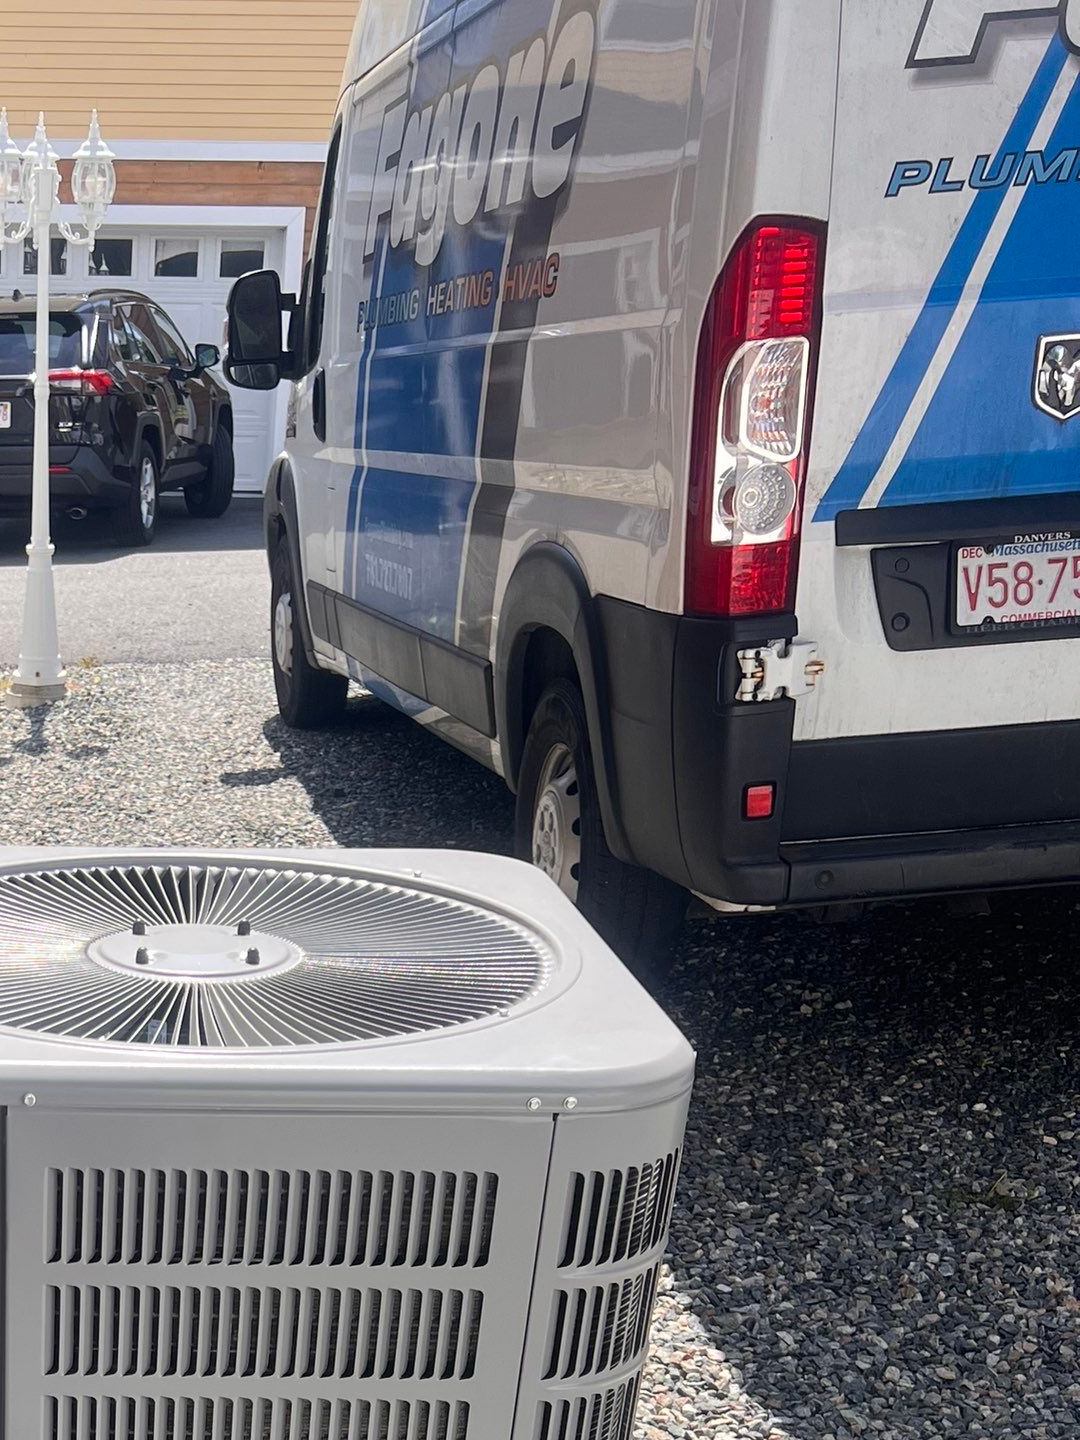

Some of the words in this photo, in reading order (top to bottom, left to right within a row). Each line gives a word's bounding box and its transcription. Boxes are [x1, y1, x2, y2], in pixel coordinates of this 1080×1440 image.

[364, 8, 598, 267] Fagone
[884, 147, 1080, 198] PLUM
[357, 288, 420, 332] PLUMBING
[426, 270, 493, 317] HEATING
[502, 252, 560, 302] HVAC
[962, 547, 983, 559] DEC
[1014, 531, 1071, 544] DANVERS
